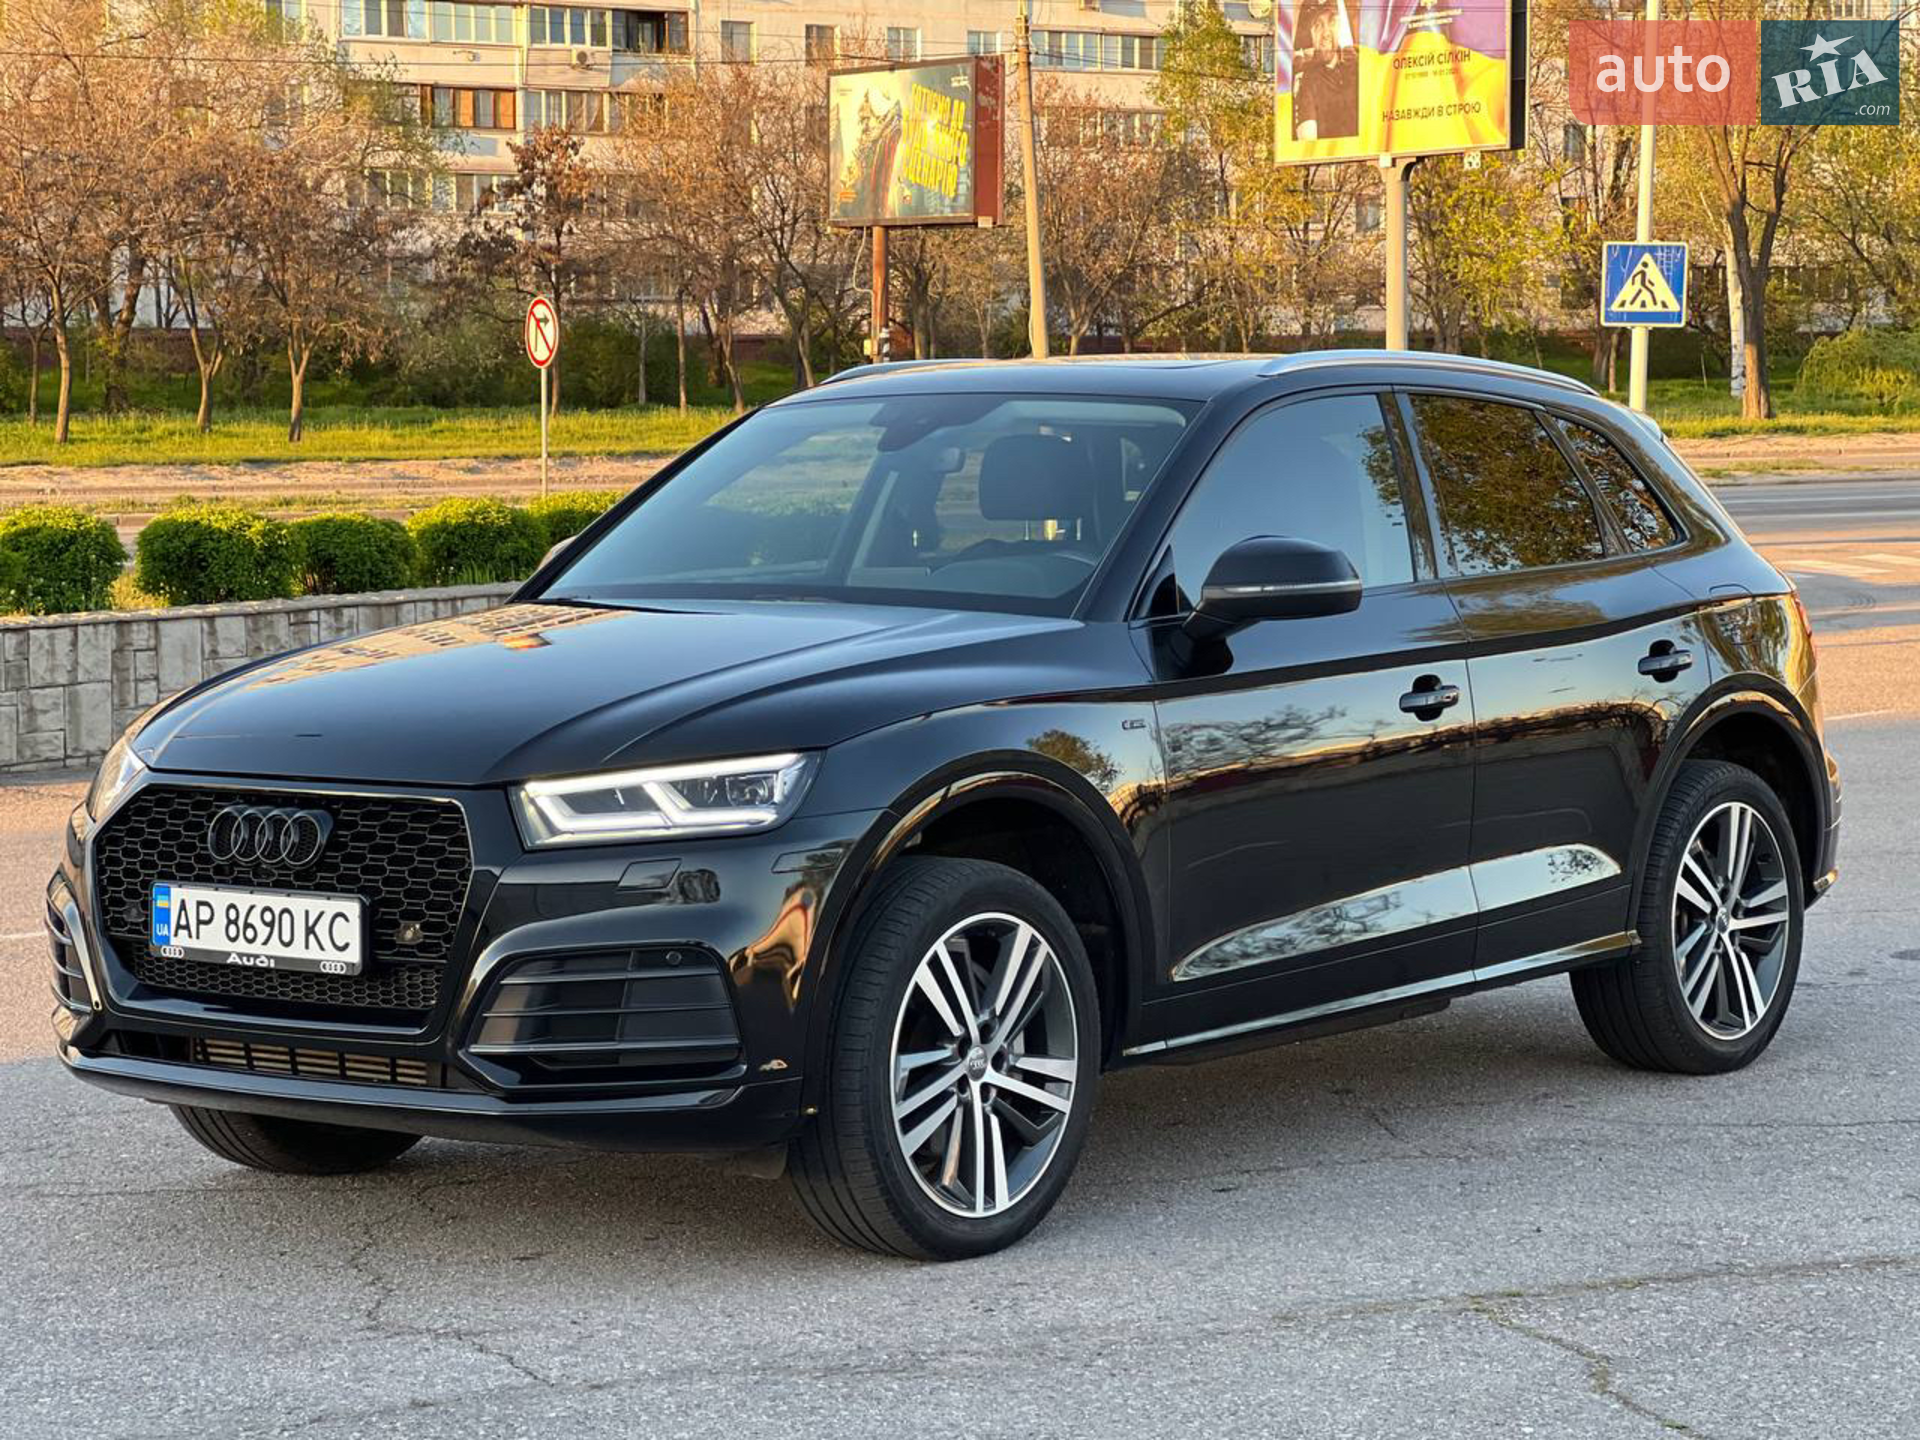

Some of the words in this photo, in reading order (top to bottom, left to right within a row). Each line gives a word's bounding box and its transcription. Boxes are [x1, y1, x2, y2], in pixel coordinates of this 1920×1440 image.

[1392, 52, 1435, 70] ОЛЕКСІЙ
[1437, 49, 1471, 65] СІЛКІН
[1382, 106, 1435, 122] НАЗАВЖДИ
[1437, 105, 1444, 117] В
[1446, 101, 1481, 117] СТРОЮ
[156, 923, 169, 936] UA
[173, 898, 215, 940] AP
[224, 902, 295, 948] 8690
[304, 909, 351, 952] KC
[226, 952, 275, 968] Audi
